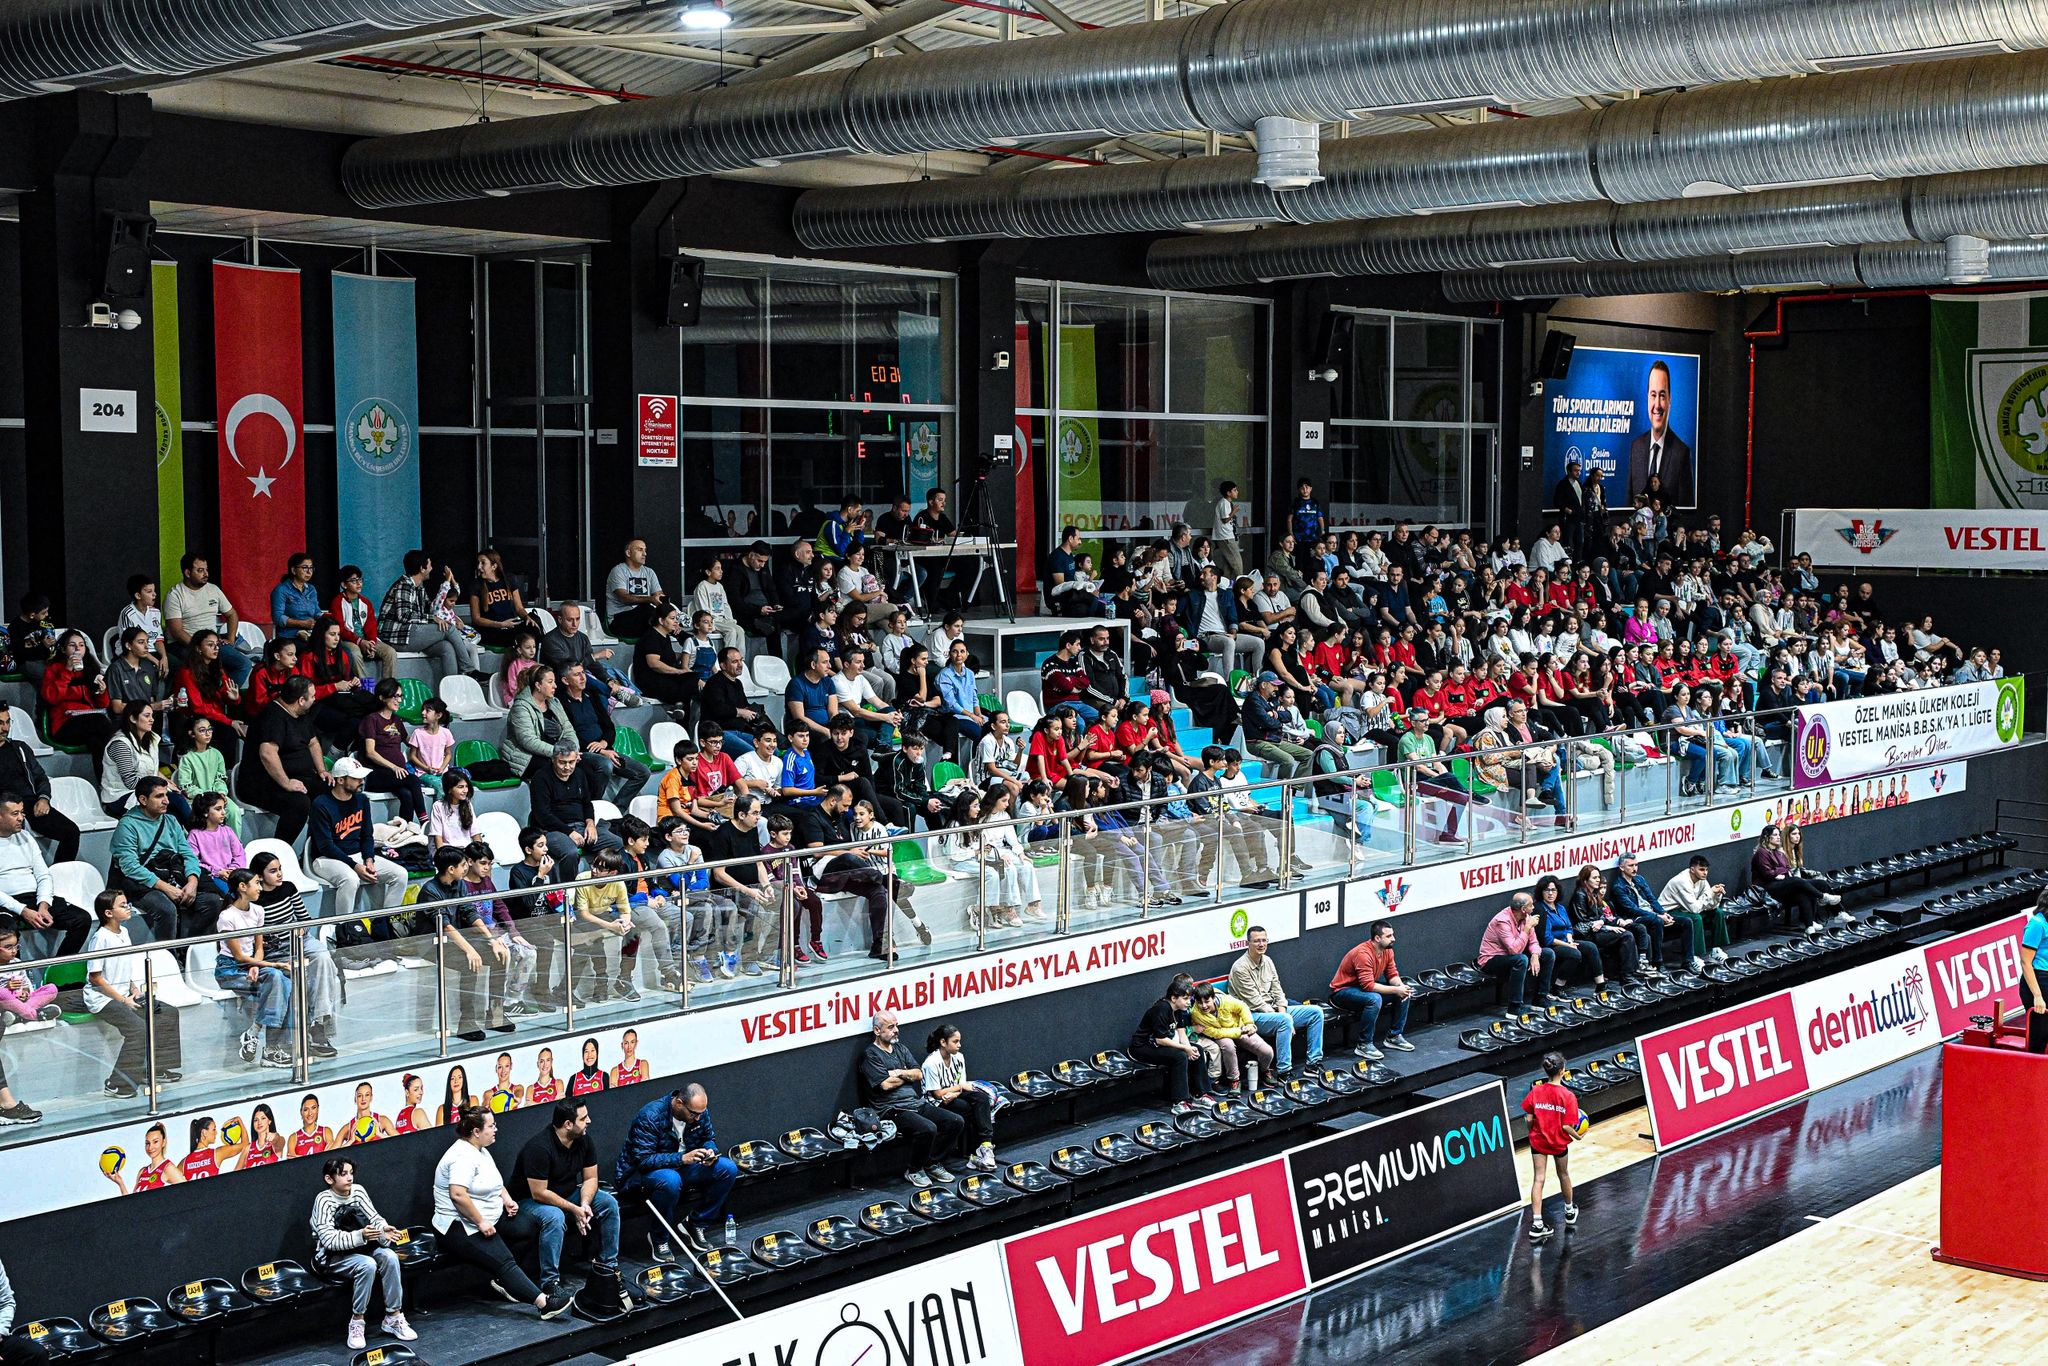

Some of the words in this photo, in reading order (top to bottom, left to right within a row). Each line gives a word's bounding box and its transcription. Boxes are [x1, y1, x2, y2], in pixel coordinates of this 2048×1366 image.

[92, 402, 125, 417] 204
[1552, 395, 1569, 414] TÜM
[1570, 398, 1635, 416] SPORCULARIMIZA
[1305, 430, 1319, 440] 203
[1556, 416, 1600, 436] BAŞARILAR
[1600, 415, 1631, 434] DİLERİM
[646, 447, 669, 455] NOKTASI
[1943, 526, 2047, 552] VESTEL
[1855, 705, 1879, 724] ÖZEL
[1881, 699, 1917, 720] MANİSA
[1919, 694, 1949, 715] ÜLKEM
[1951, 688, 1980, 710] KOLEJİ
[1838, 727, 1874, 748] VESTEL
[1875, 721, 1911, 742] MANİSA
[1969, 709, 1992, 726] LİGTE
[1528, 845, 1566, 875] KALBİ
[1569, 833, 1646, 867] MANİSA'YLA
[1650, 822, 1696, 851] ATIYOR!
[1314, 900, 1331, 914] 103
[868, 972, 936, 1018] KALBİ
[942, 949, 1080, 1001] MANİSA'YLA
[1086, 931, 1166, 972] ATIYOR!
[1657, 1017, 1793, 1111] VESTEL
[1535, 1102, 1555, 1111] MANİSA
[260, 1266, 273, 1277] CA3-9
[1035, 1193, 1280, 1336] VESTEL
[187, 1285, 201, 1296] CA3-8
[110, 1304, 124, 1315] CA3-7
